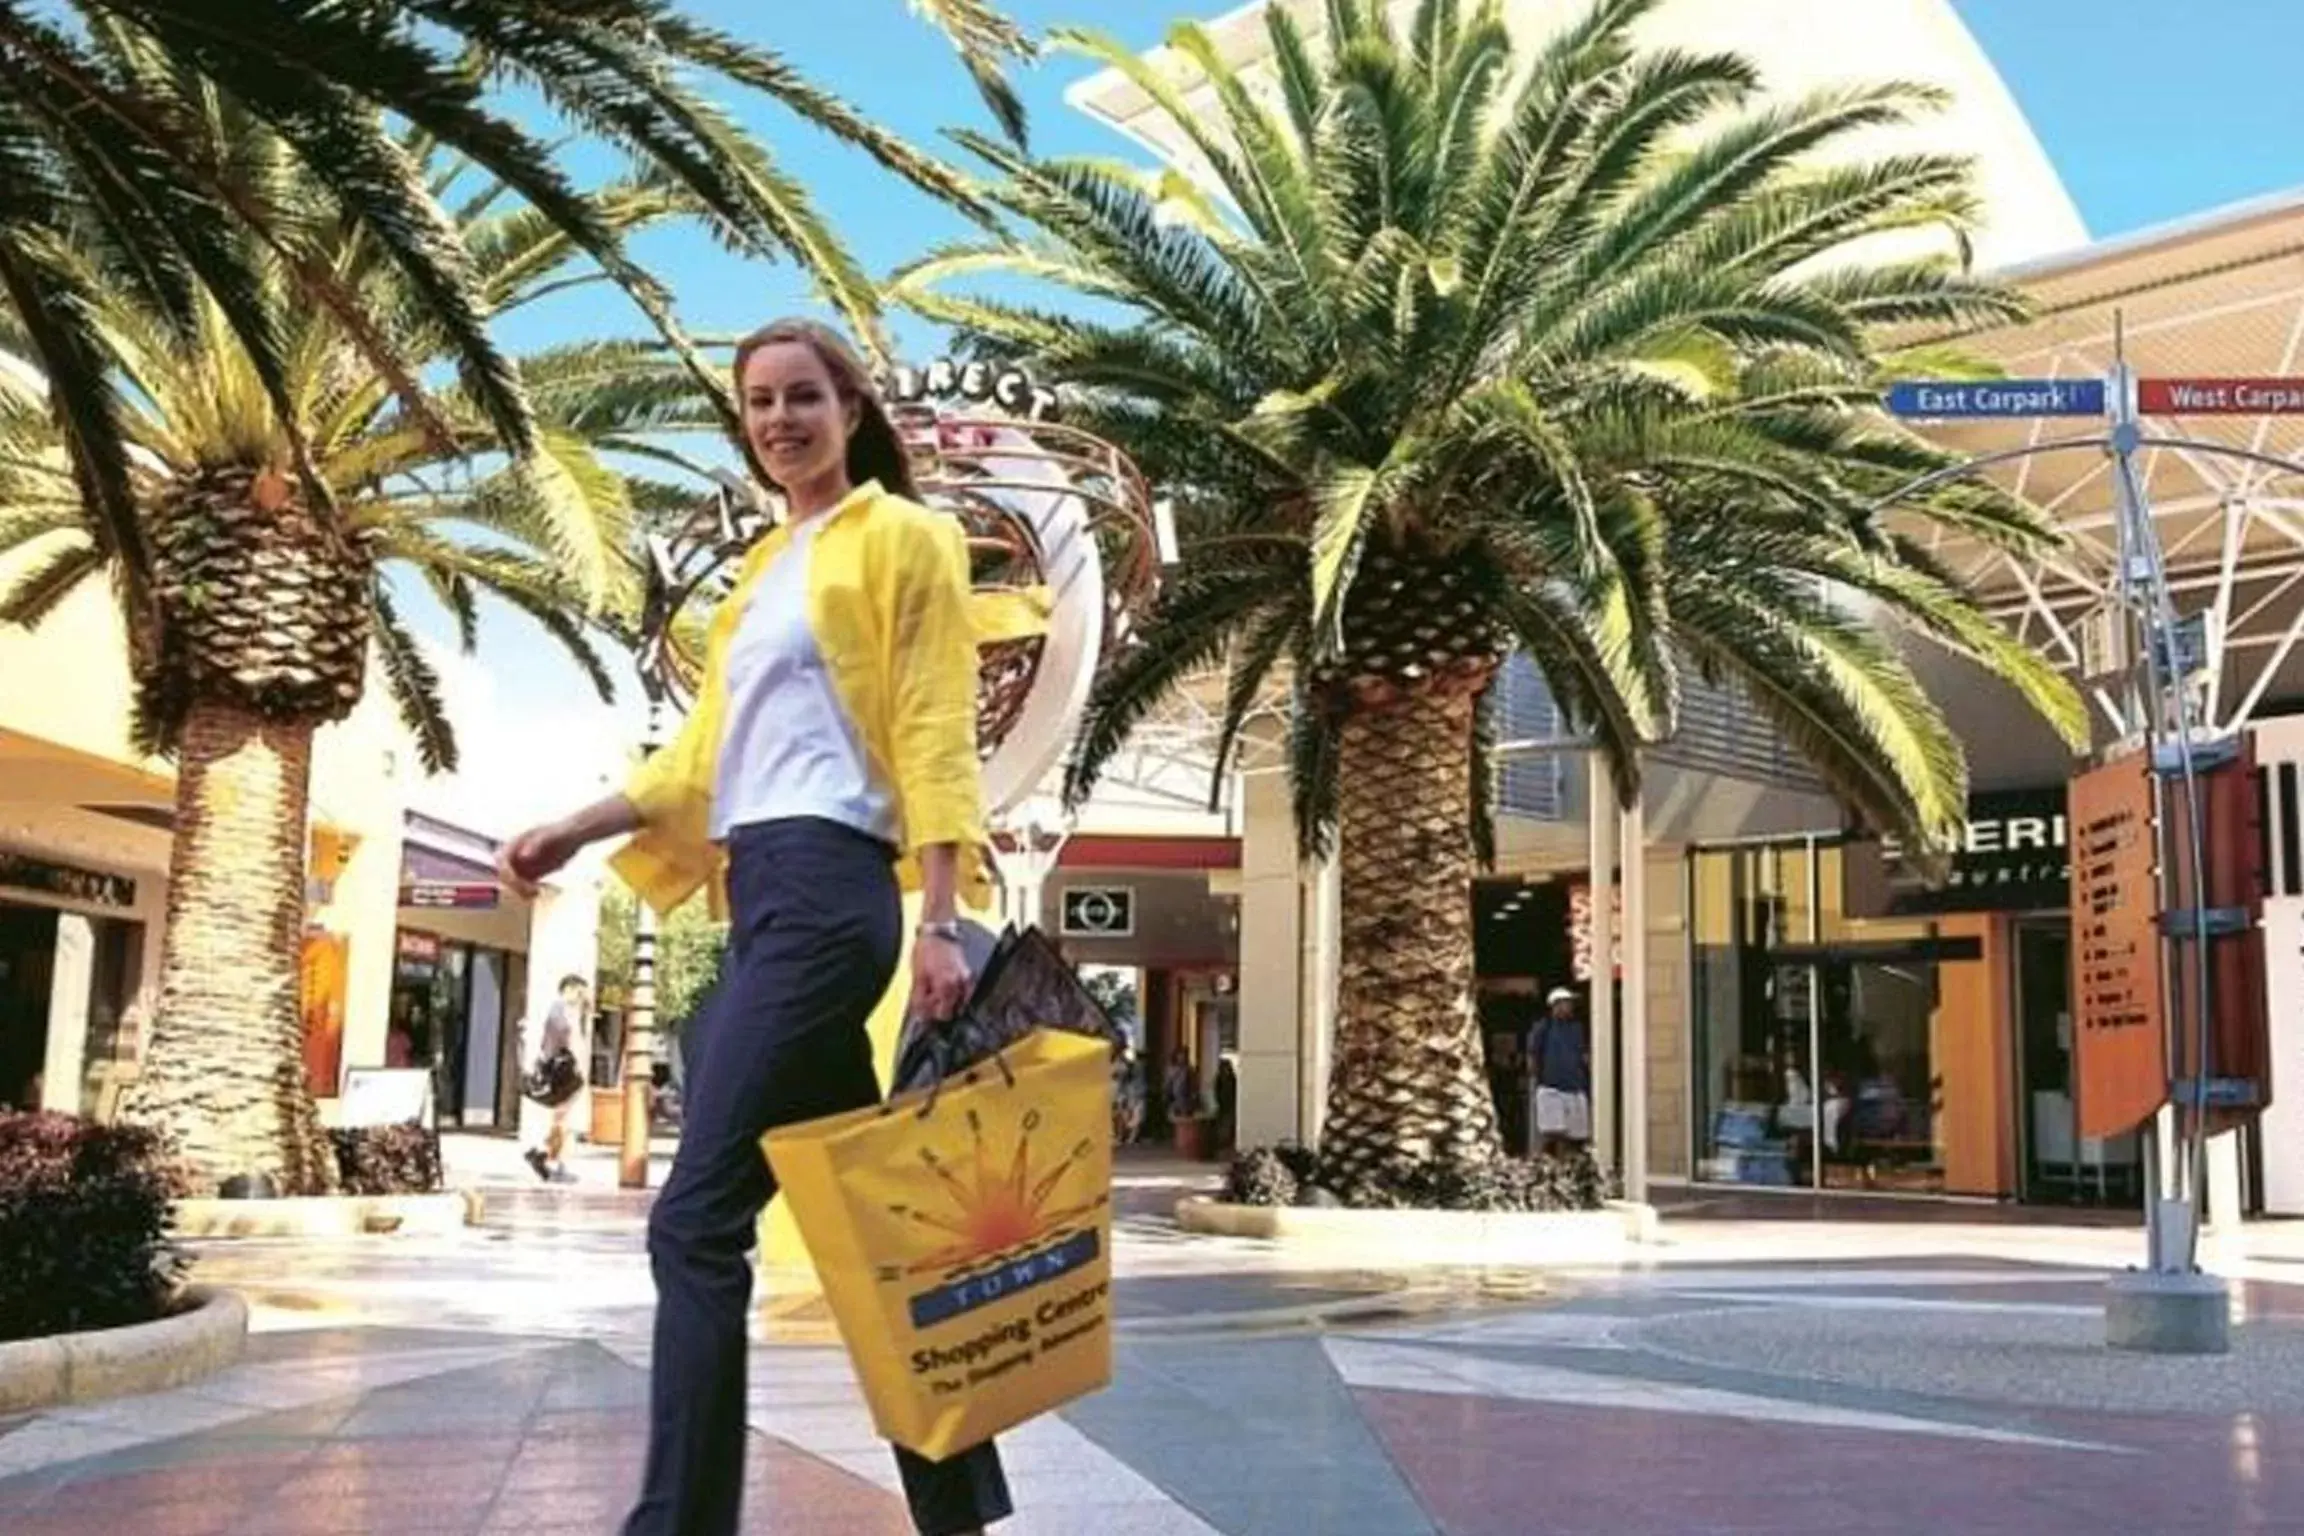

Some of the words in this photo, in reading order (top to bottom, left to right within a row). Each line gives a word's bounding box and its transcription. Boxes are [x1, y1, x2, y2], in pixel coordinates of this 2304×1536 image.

[1918, 388, 1965, 410] East
[1975, 387, 2066, 413] Carpark
[2169, 386, 2226, 407] West
[2235, 385, 2304, 411] Carpa
[911, 1318, 1032, 1374] Shopping
